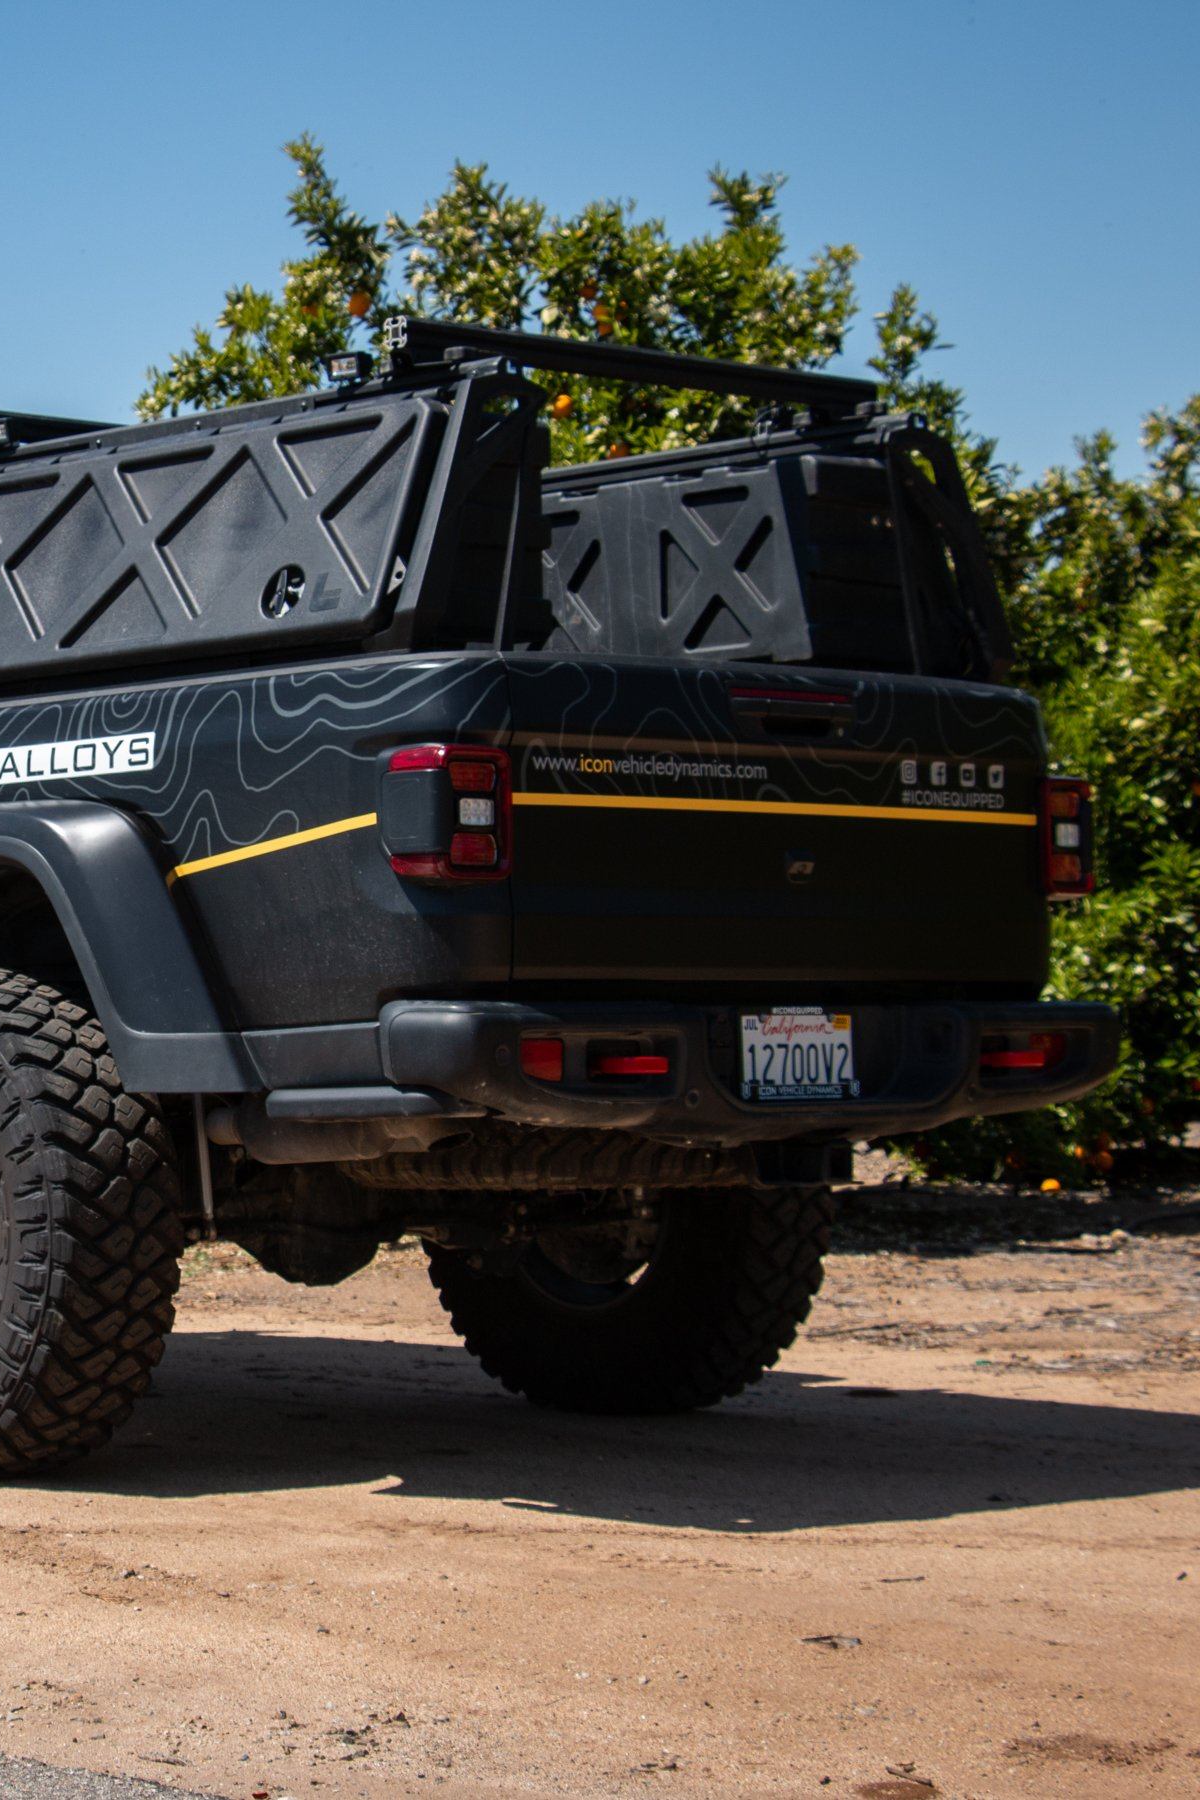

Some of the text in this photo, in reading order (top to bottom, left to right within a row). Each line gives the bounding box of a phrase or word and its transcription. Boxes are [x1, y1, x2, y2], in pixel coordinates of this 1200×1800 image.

[532, 754, 767, 783] www.iconvehicledynamics.com
[901, 789, 1005, 809] #ICONEQUIPPED
[744, 1018, 758, 1031] JUL
[761, 1015, 834, 1041] California
[749, 1043, 851, 1085] 12700V2
[758, 1085, 842, 1096] ICON VEHICLE DYNAMICS
